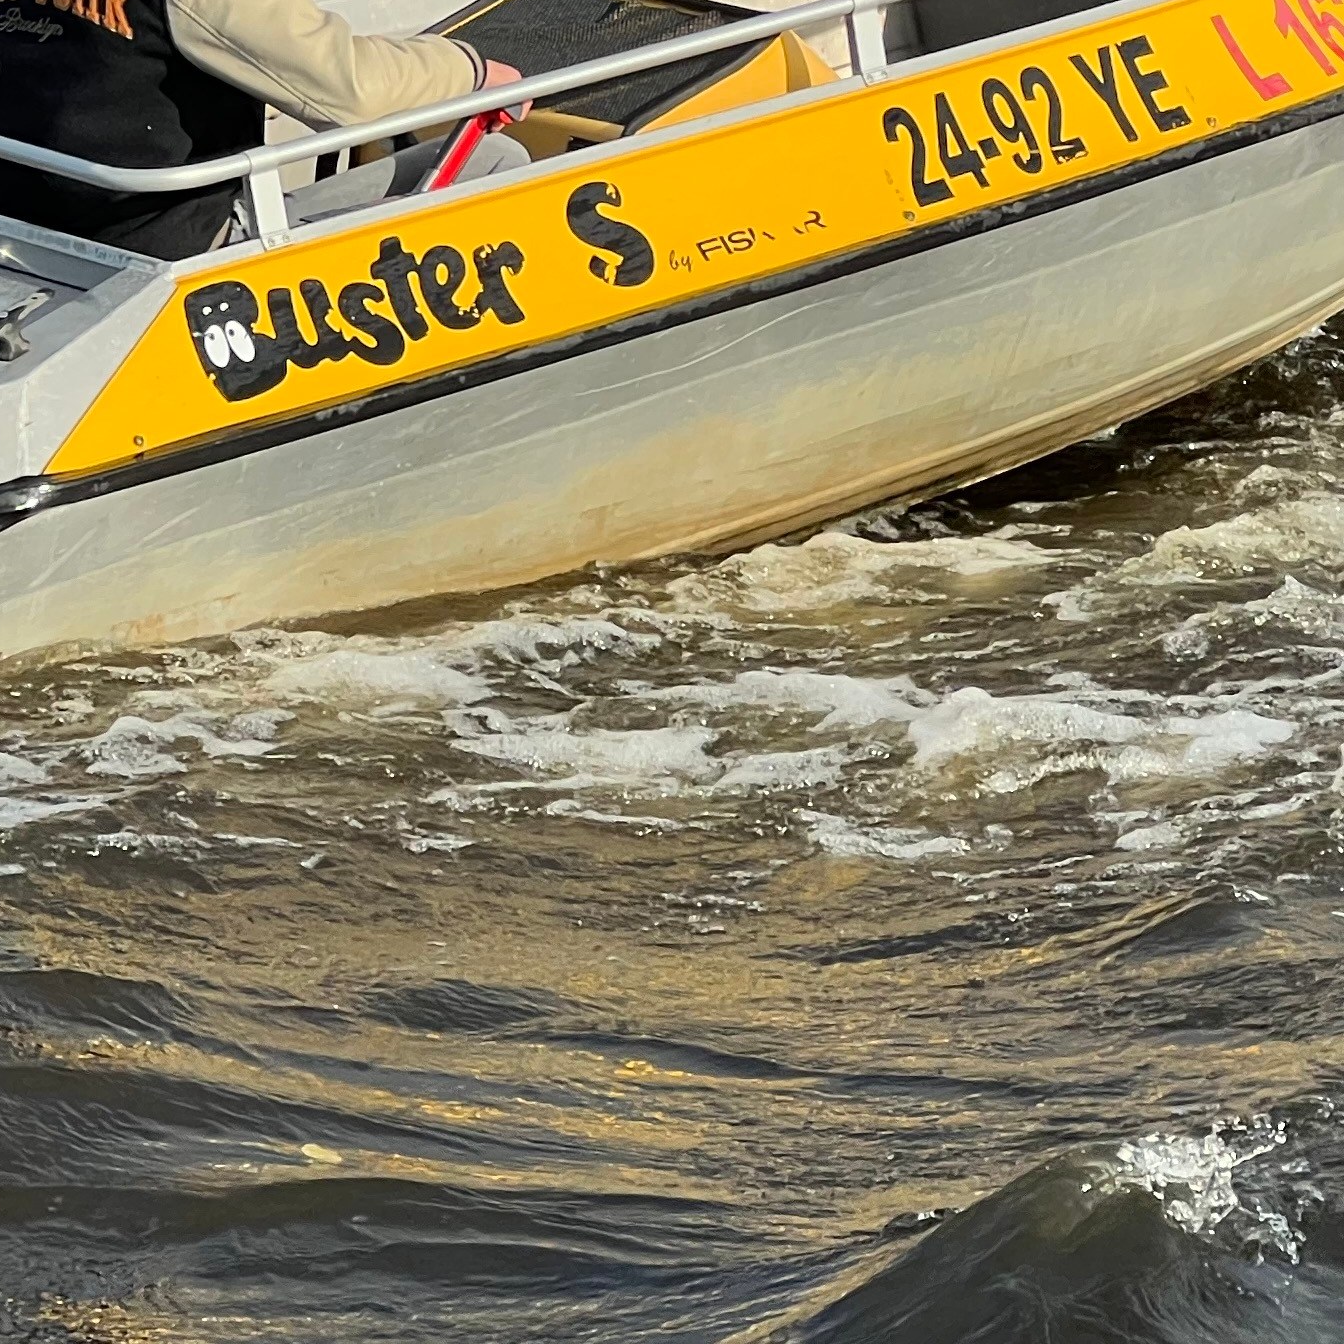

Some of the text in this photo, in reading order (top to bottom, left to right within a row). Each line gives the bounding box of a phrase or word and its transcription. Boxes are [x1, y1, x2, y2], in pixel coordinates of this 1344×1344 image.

[883, 35, 1191, 207] 24-92 YE
[1211, 15, 1292, 101] L
[184, 182, 655, 402] Buster S
[669, 249, 692, 273] by
